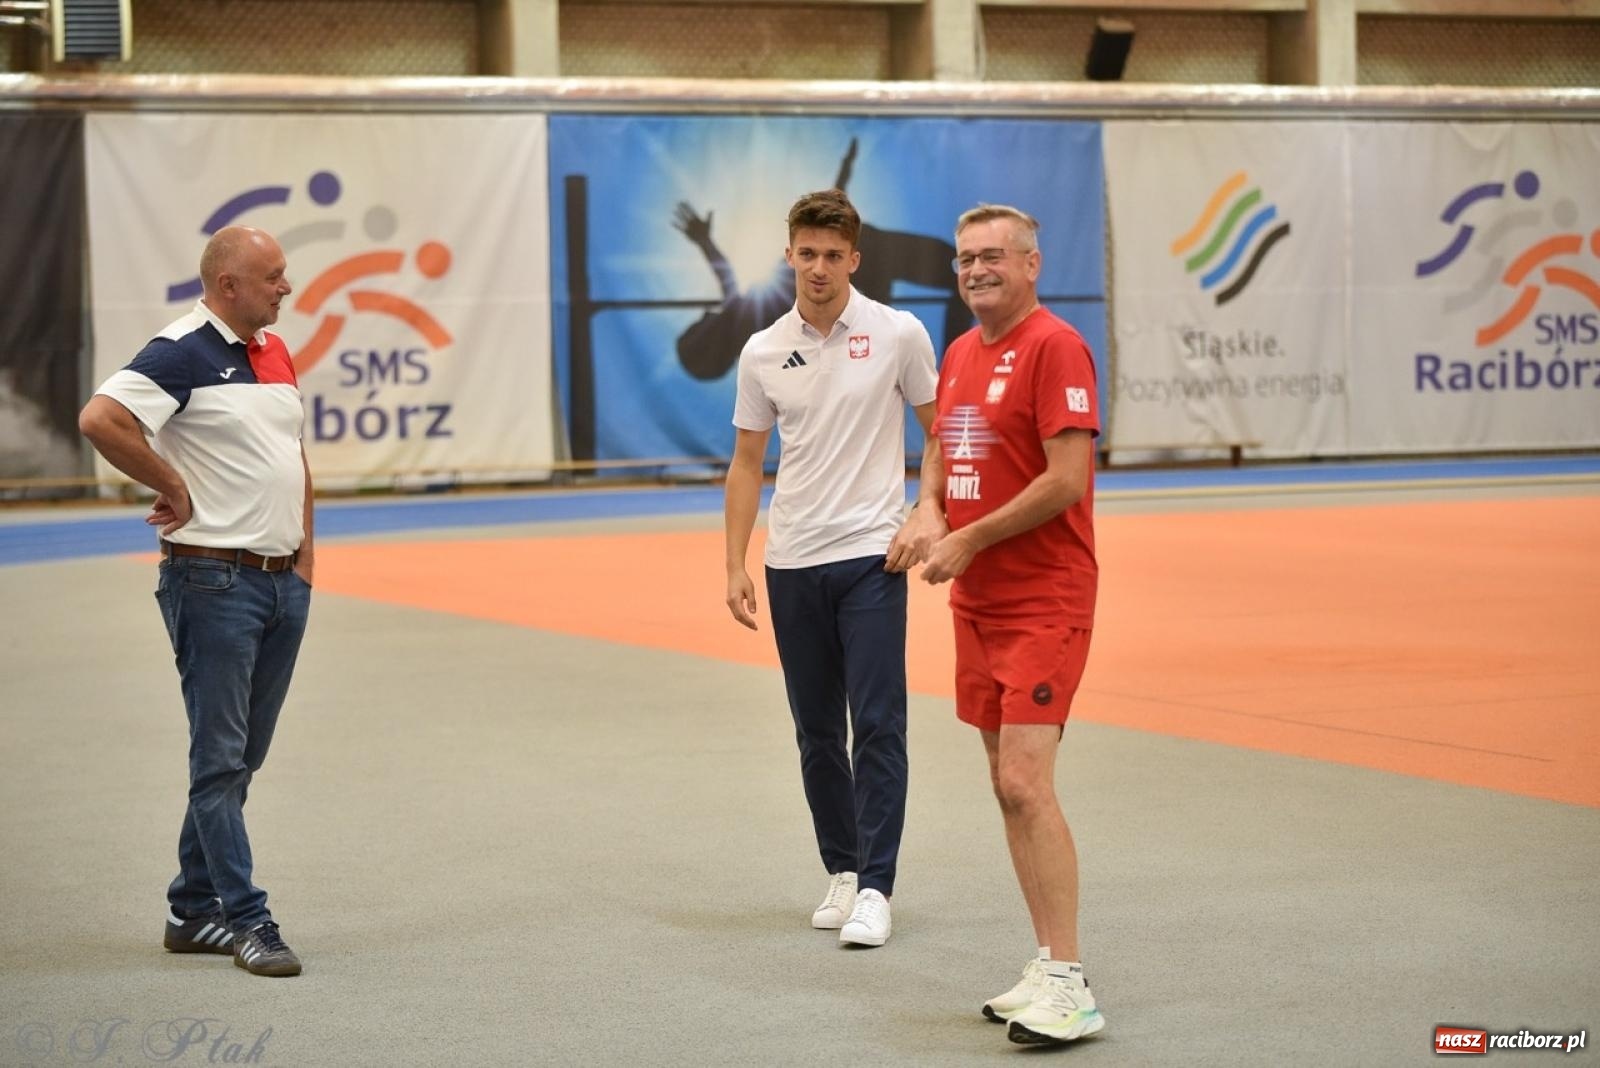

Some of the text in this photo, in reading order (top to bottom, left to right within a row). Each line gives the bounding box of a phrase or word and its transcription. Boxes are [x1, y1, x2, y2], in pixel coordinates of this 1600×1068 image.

[1535, 313, 1600, 346] SMS
[338, 349, 431, 387] SMS
[1254, 366, 1346, 404] energia
[301, 389, 454, 443] bórz
